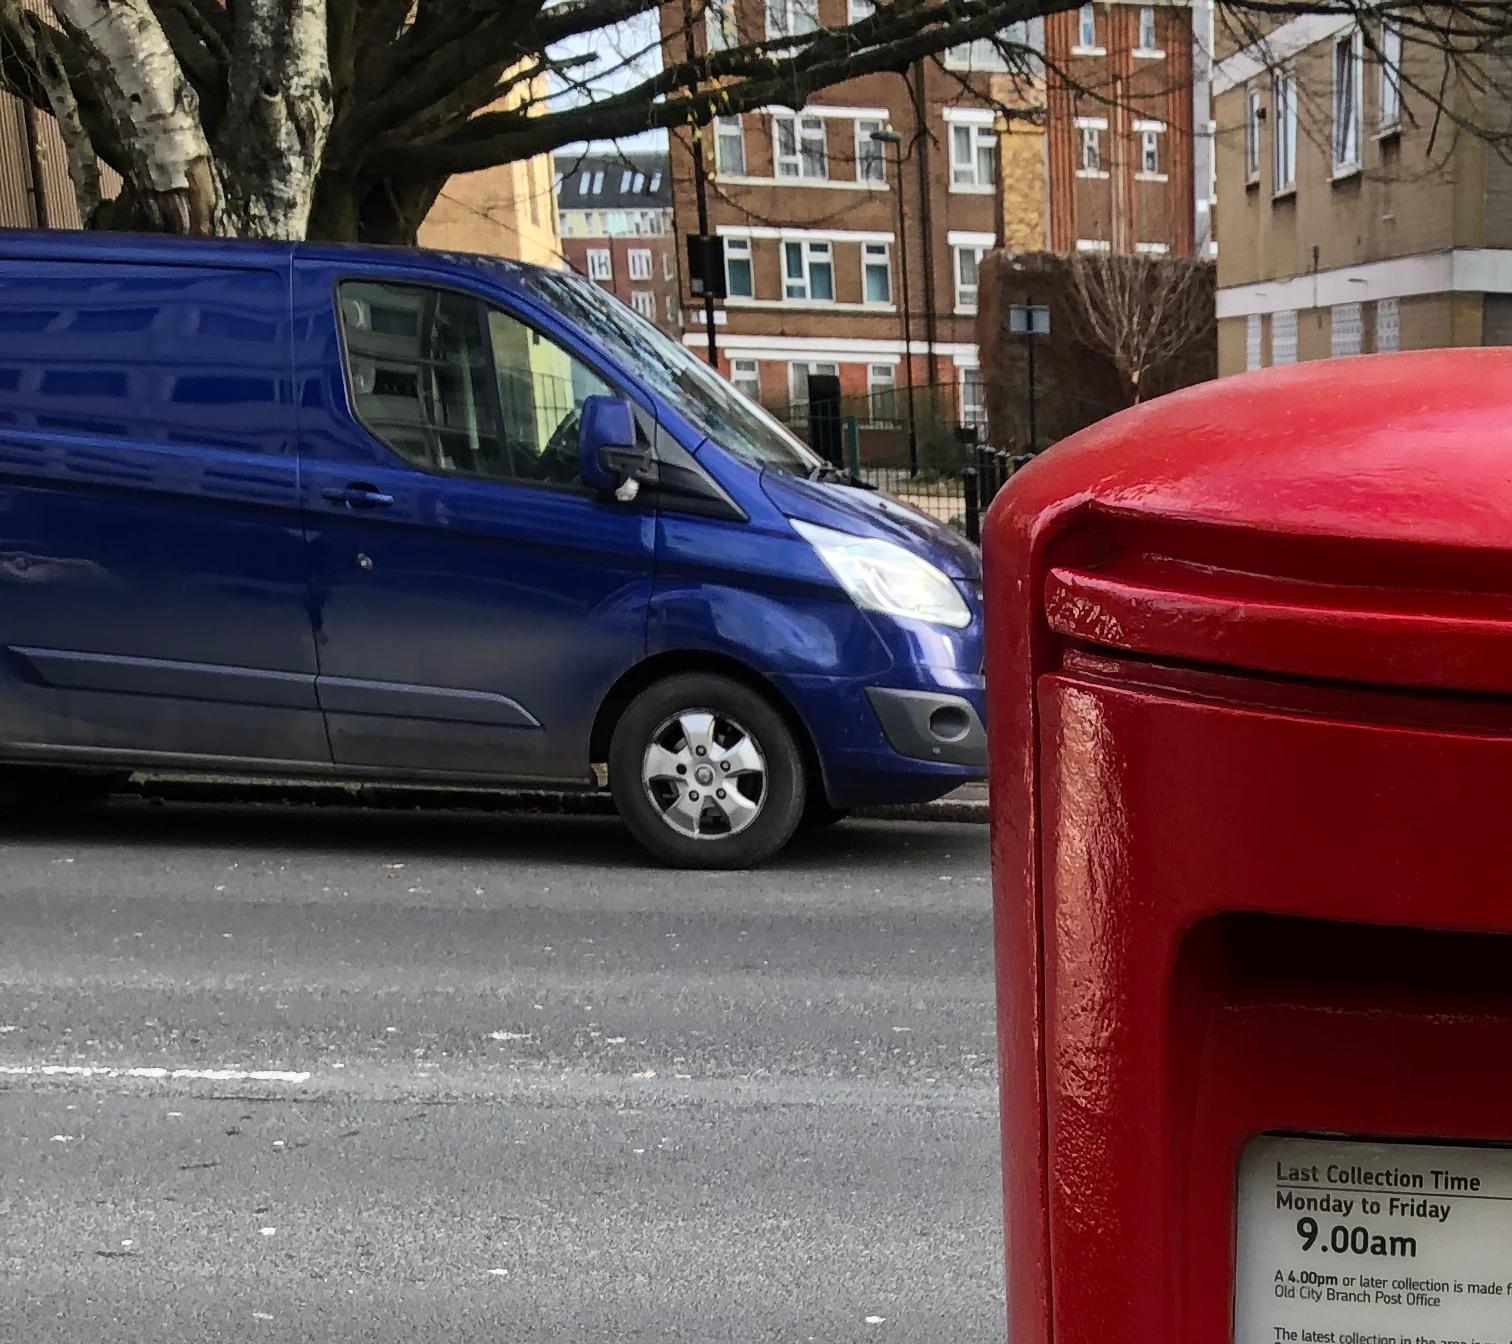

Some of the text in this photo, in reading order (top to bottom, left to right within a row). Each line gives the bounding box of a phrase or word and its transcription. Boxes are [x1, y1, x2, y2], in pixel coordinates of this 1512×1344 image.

[1276, 1161, 1481, 1192] Last Collection Time
[1276, 1191, 1451, 1223] Monday to Friday
[1296, 1216, 1417, 1258] 9.00am
[1274, 1269, 1284, 1283] A
[1288, 1270, 1338, 1287] 4.00pm
[1342, 1276, 1356, 1287] or
[1359, 1275, 1388, 1290] later
[1392, 1277, 1450, 1293] collection
[1453, 1280, 1464, 1294] is
[1467, 1282, 1504, 1296] made
[1274, 1284, 1441, 1307] Old City Branch Post Office
[1273, 1326, 1298, 1342] The
[1301, 1329, 1336, 1344] latest
